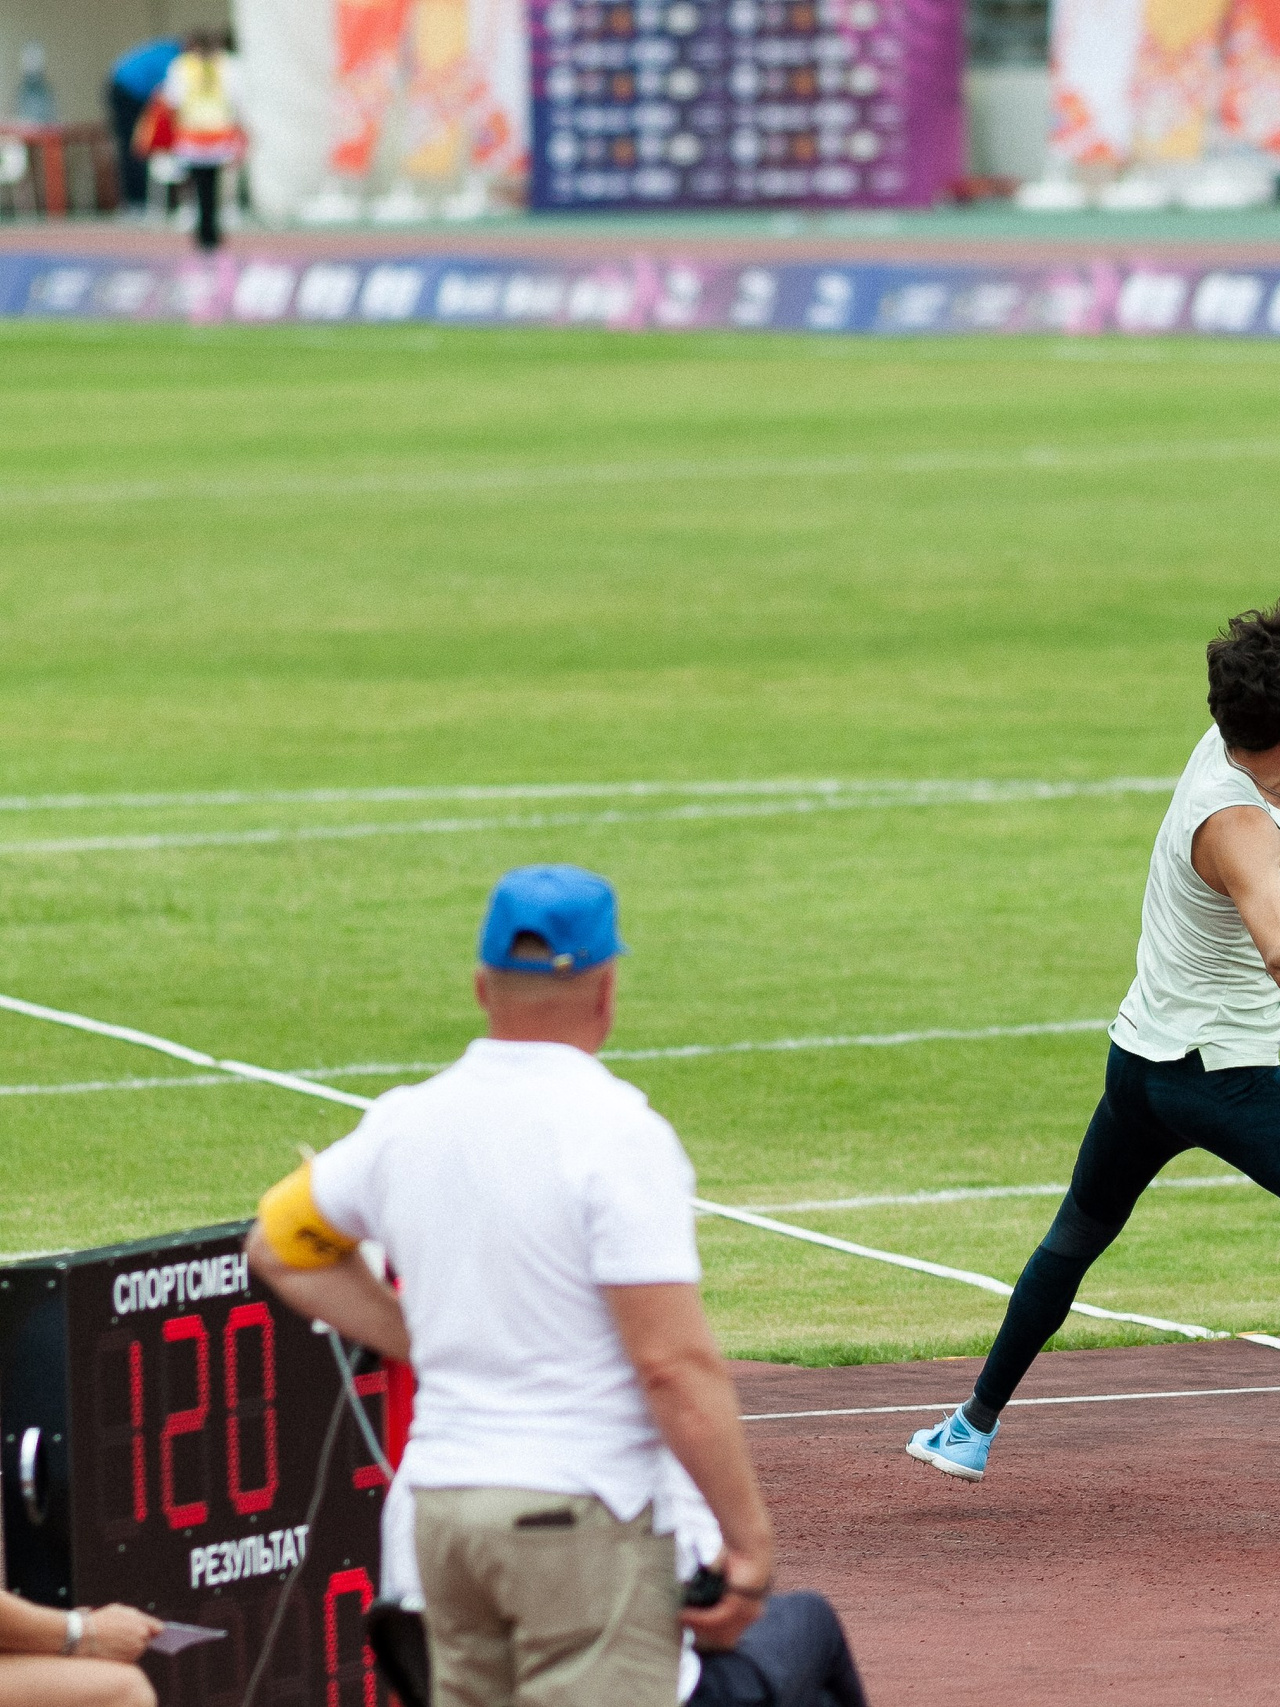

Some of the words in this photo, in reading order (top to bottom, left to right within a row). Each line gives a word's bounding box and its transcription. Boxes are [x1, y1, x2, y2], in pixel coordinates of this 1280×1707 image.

[113, 1251, 249, 1315] СПОРТСМЕН
[129, 1301, 280, 1530] 120
[190, 1523, 310, 1590] РЕЗУЛЬТАТ
